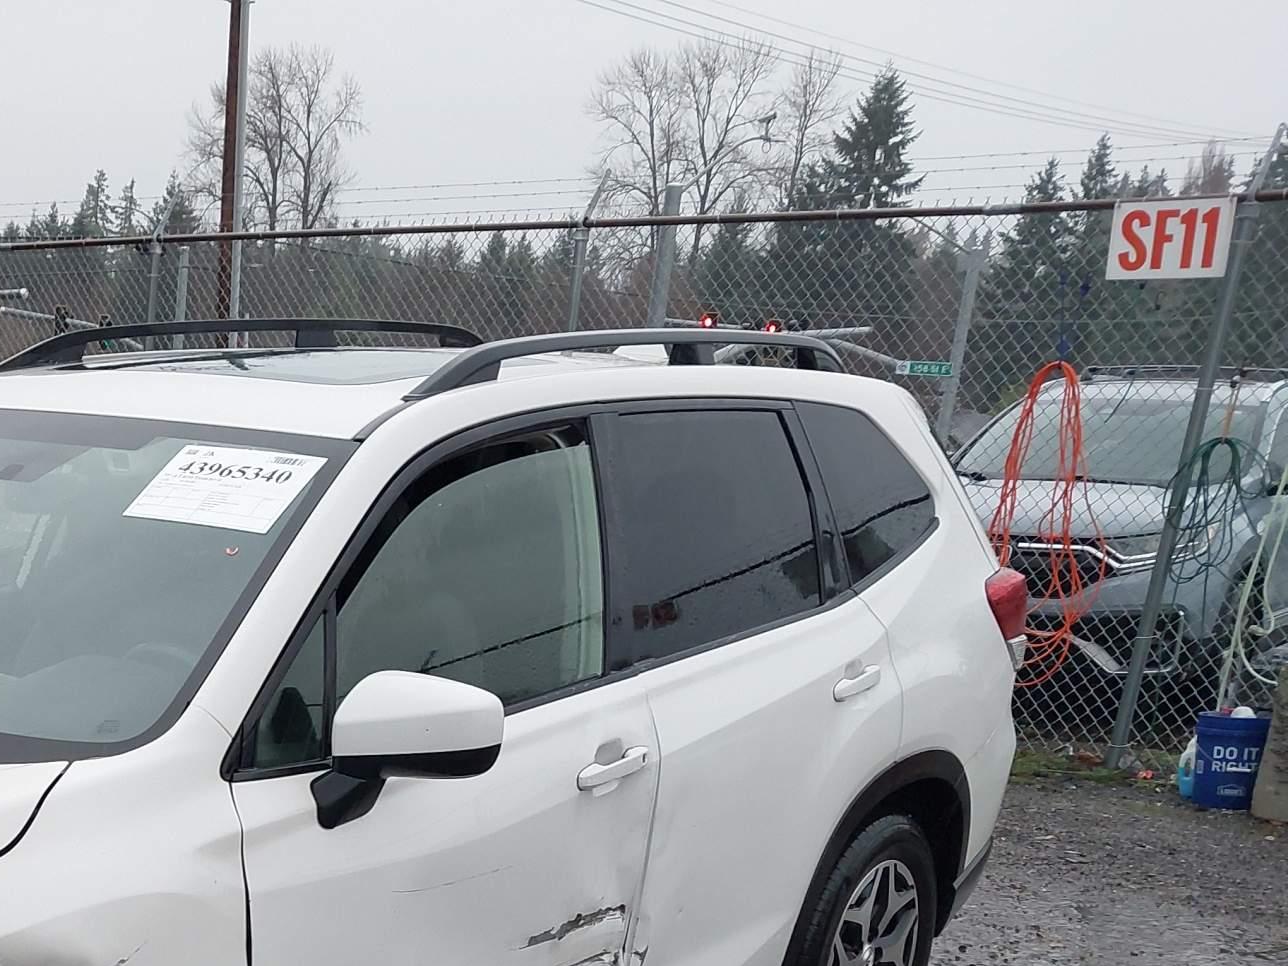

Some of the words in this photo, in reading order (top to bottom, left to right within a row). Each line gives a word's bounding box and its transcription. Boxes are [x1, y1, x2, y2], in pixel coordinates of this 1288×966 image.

[1118, 207, 1221, 272] SF11
[178, 460, 292, 484] 43965340
[1213, 746, 1238, 760] DO
[1243, 747, 1260, 761] IT
[1211, 761, 1258, 773] RIGHT
